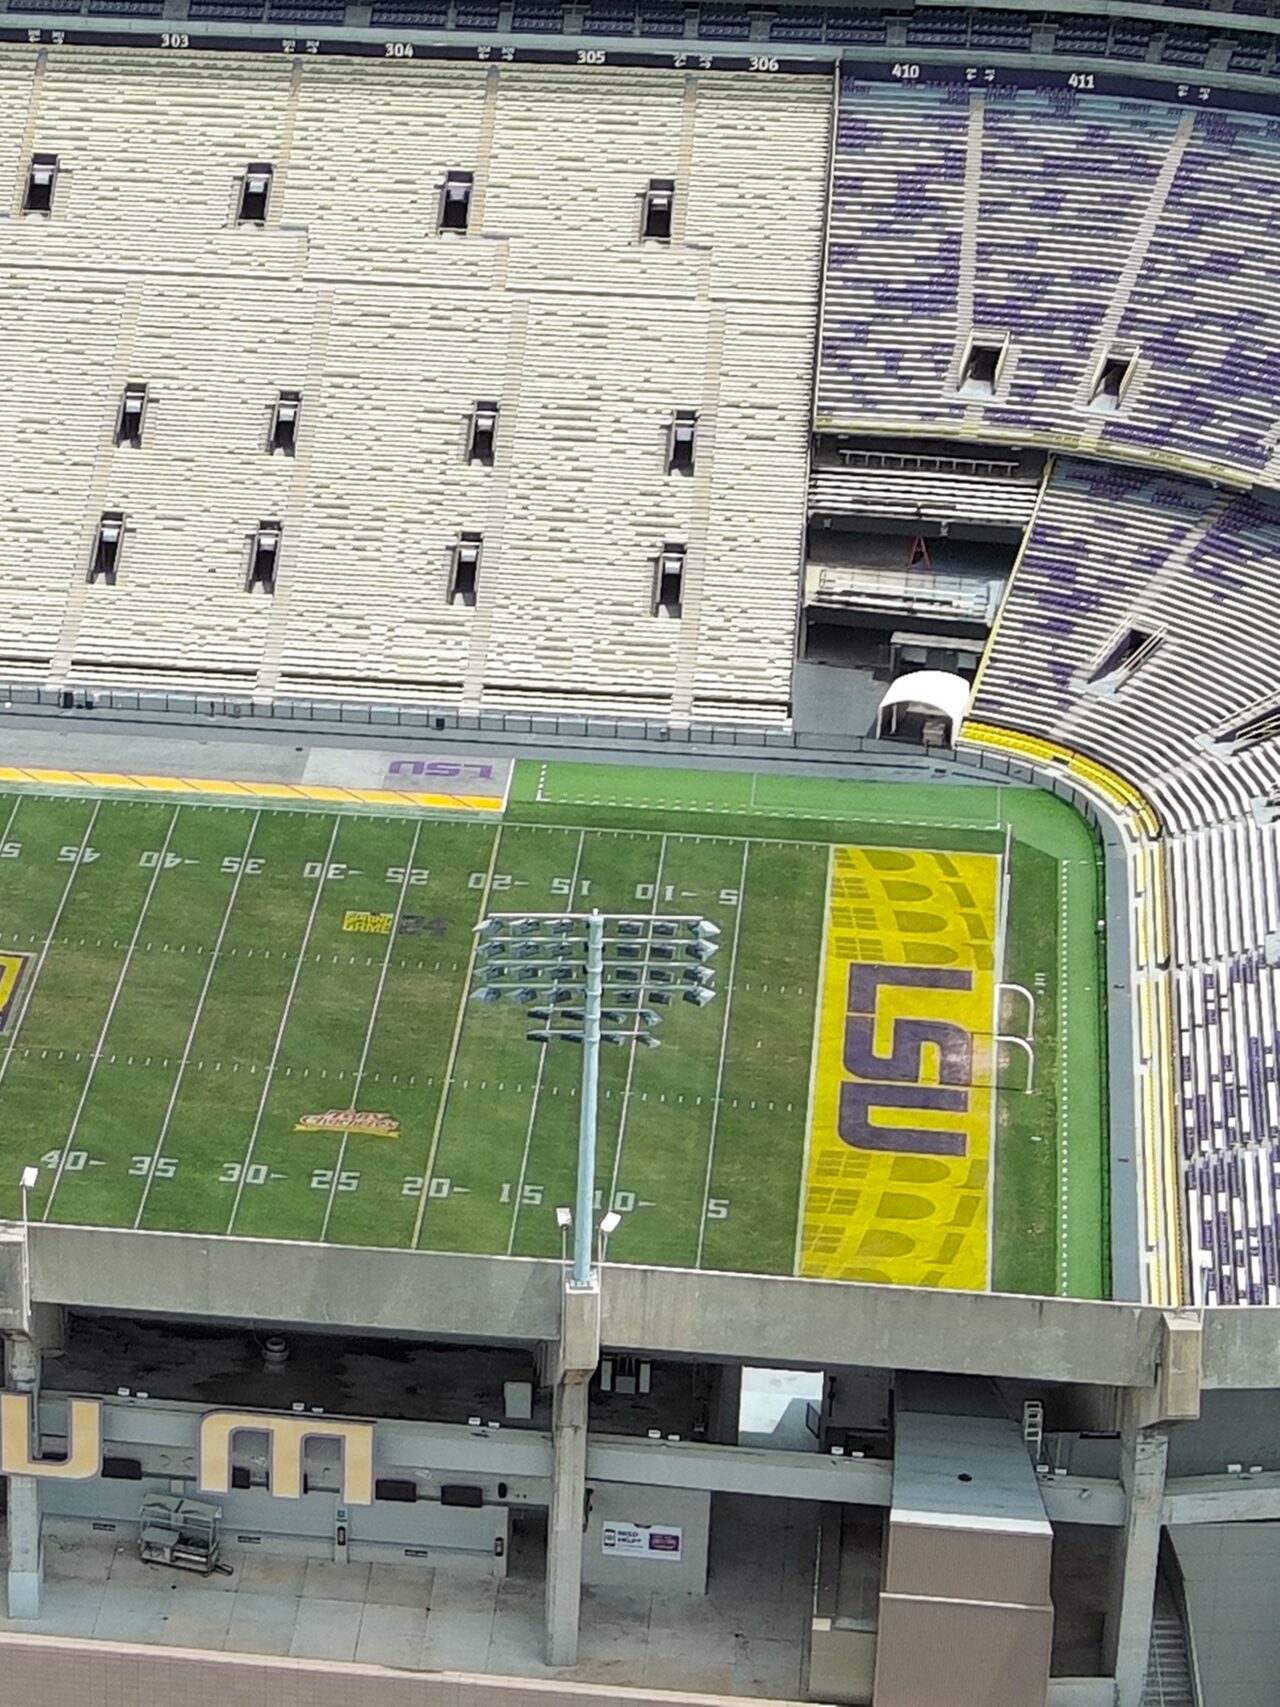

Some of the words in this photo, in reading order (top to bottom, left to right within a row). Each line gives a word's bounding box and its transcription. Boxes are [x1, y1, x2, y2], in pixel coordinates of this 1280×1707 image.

[161, 34, 189, 47] 303
[385, 43, 414, 57] 304
[577, 51, 606, 64] 305
[749, 57, 779, 71] 306
[891, 64, 920, 78] 410
[1068, 74, 1095, 89] 411
[389, 760, 493, 779] LSU
[57, 846, 101, 863] 45
[139, 851, 185, 868] 40
[221, 856, 266, 874] 35
[303, 862, 348, 880] 30
[385, 868, 430, 885] 25
[468, 872, 513, 890] 20
[550, 878, 592, 895] 15
[635, 883, 675, 901] 10
[718, 889, 739, 905] 5
[837, 962, 973, 1157] LSU
[40, 1149, 88, 1171] 40
[128, 1157, 178, 1179] 35
[219, 1162, 268, 1186] 30
[311, 1169, 360, 1192] 25
[402, 1176, 452, 1199] 20
[500, 1183, 544, 1206] 15
[594, 1190, 636, 1212] 10
[708, 1199, 730, 1220] 5
